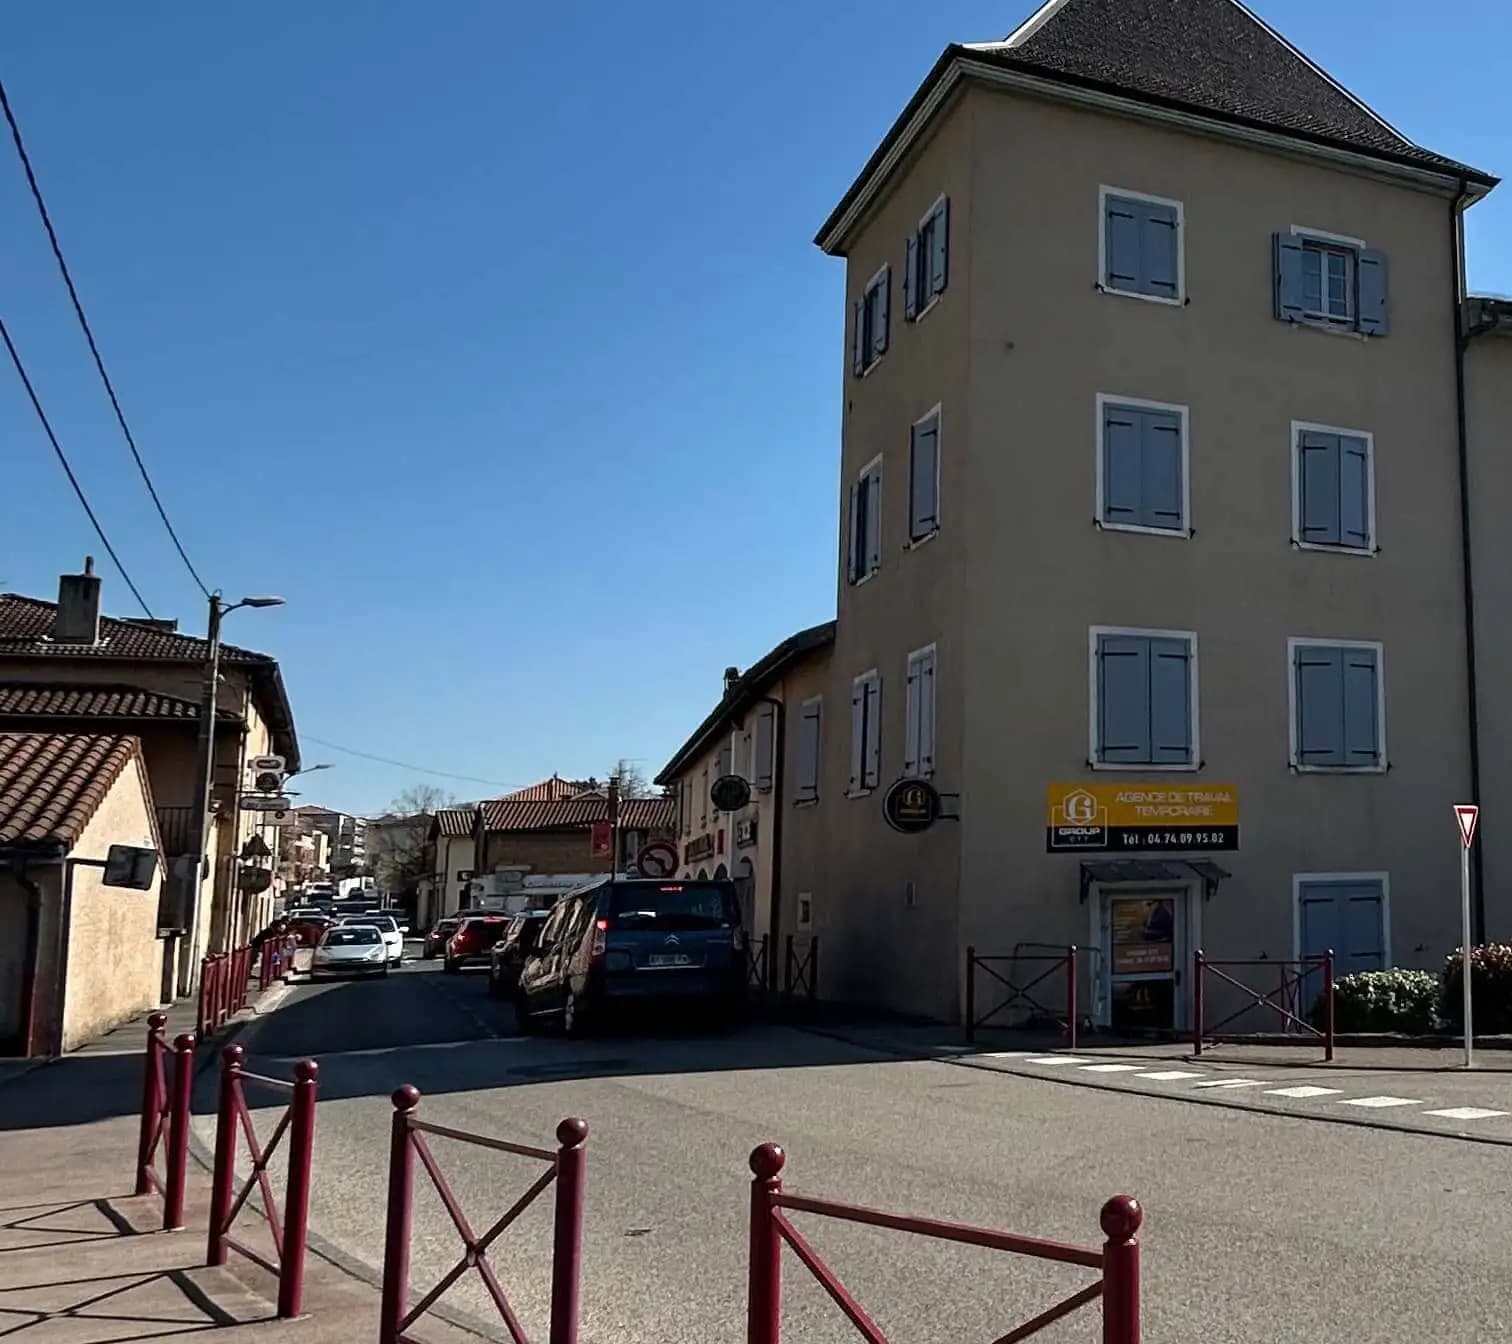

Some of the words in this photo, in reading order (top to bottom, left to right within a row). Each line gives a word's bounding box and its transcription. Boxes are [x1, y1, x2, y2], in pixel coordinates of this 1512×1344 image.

[1116, 791, 1166, 803] AGENCE
[1168, 791, 1187, 803] DE
[1135, 804, 1216, 816] TEMPORAIRE
[1058, 827, 1100, 835] GROUP
